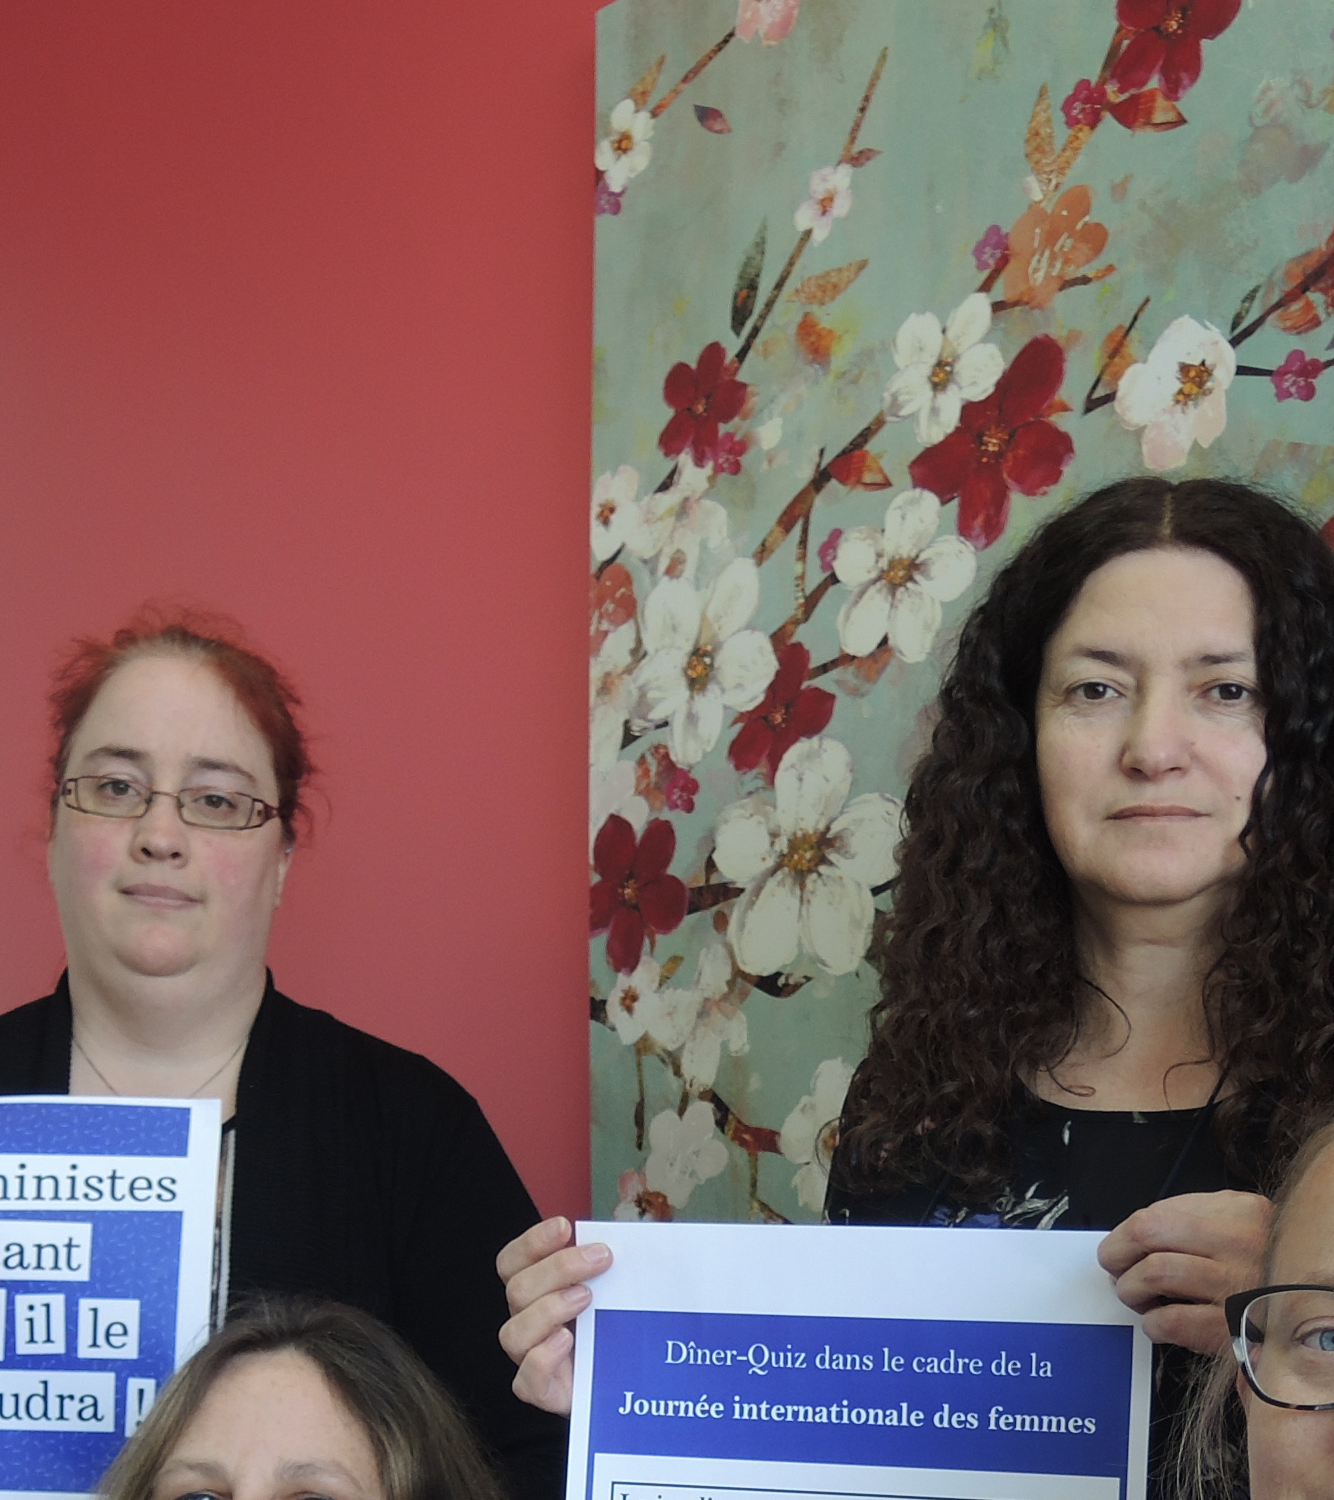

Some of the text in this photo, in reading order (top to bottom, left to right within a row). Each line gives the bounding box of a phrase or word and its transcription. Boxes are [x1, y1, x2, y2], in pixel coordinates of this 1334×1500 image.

[25, 1302, 55, 1345] il
[89, 1308, 128, 1348] le
[665, 1339, 1053, 1378] Dîner-Quiz dans le cadre de la
[136, 1388, 144, 1426] !
[618, 1391, 1096, 1434] Journée internationale des femmes
